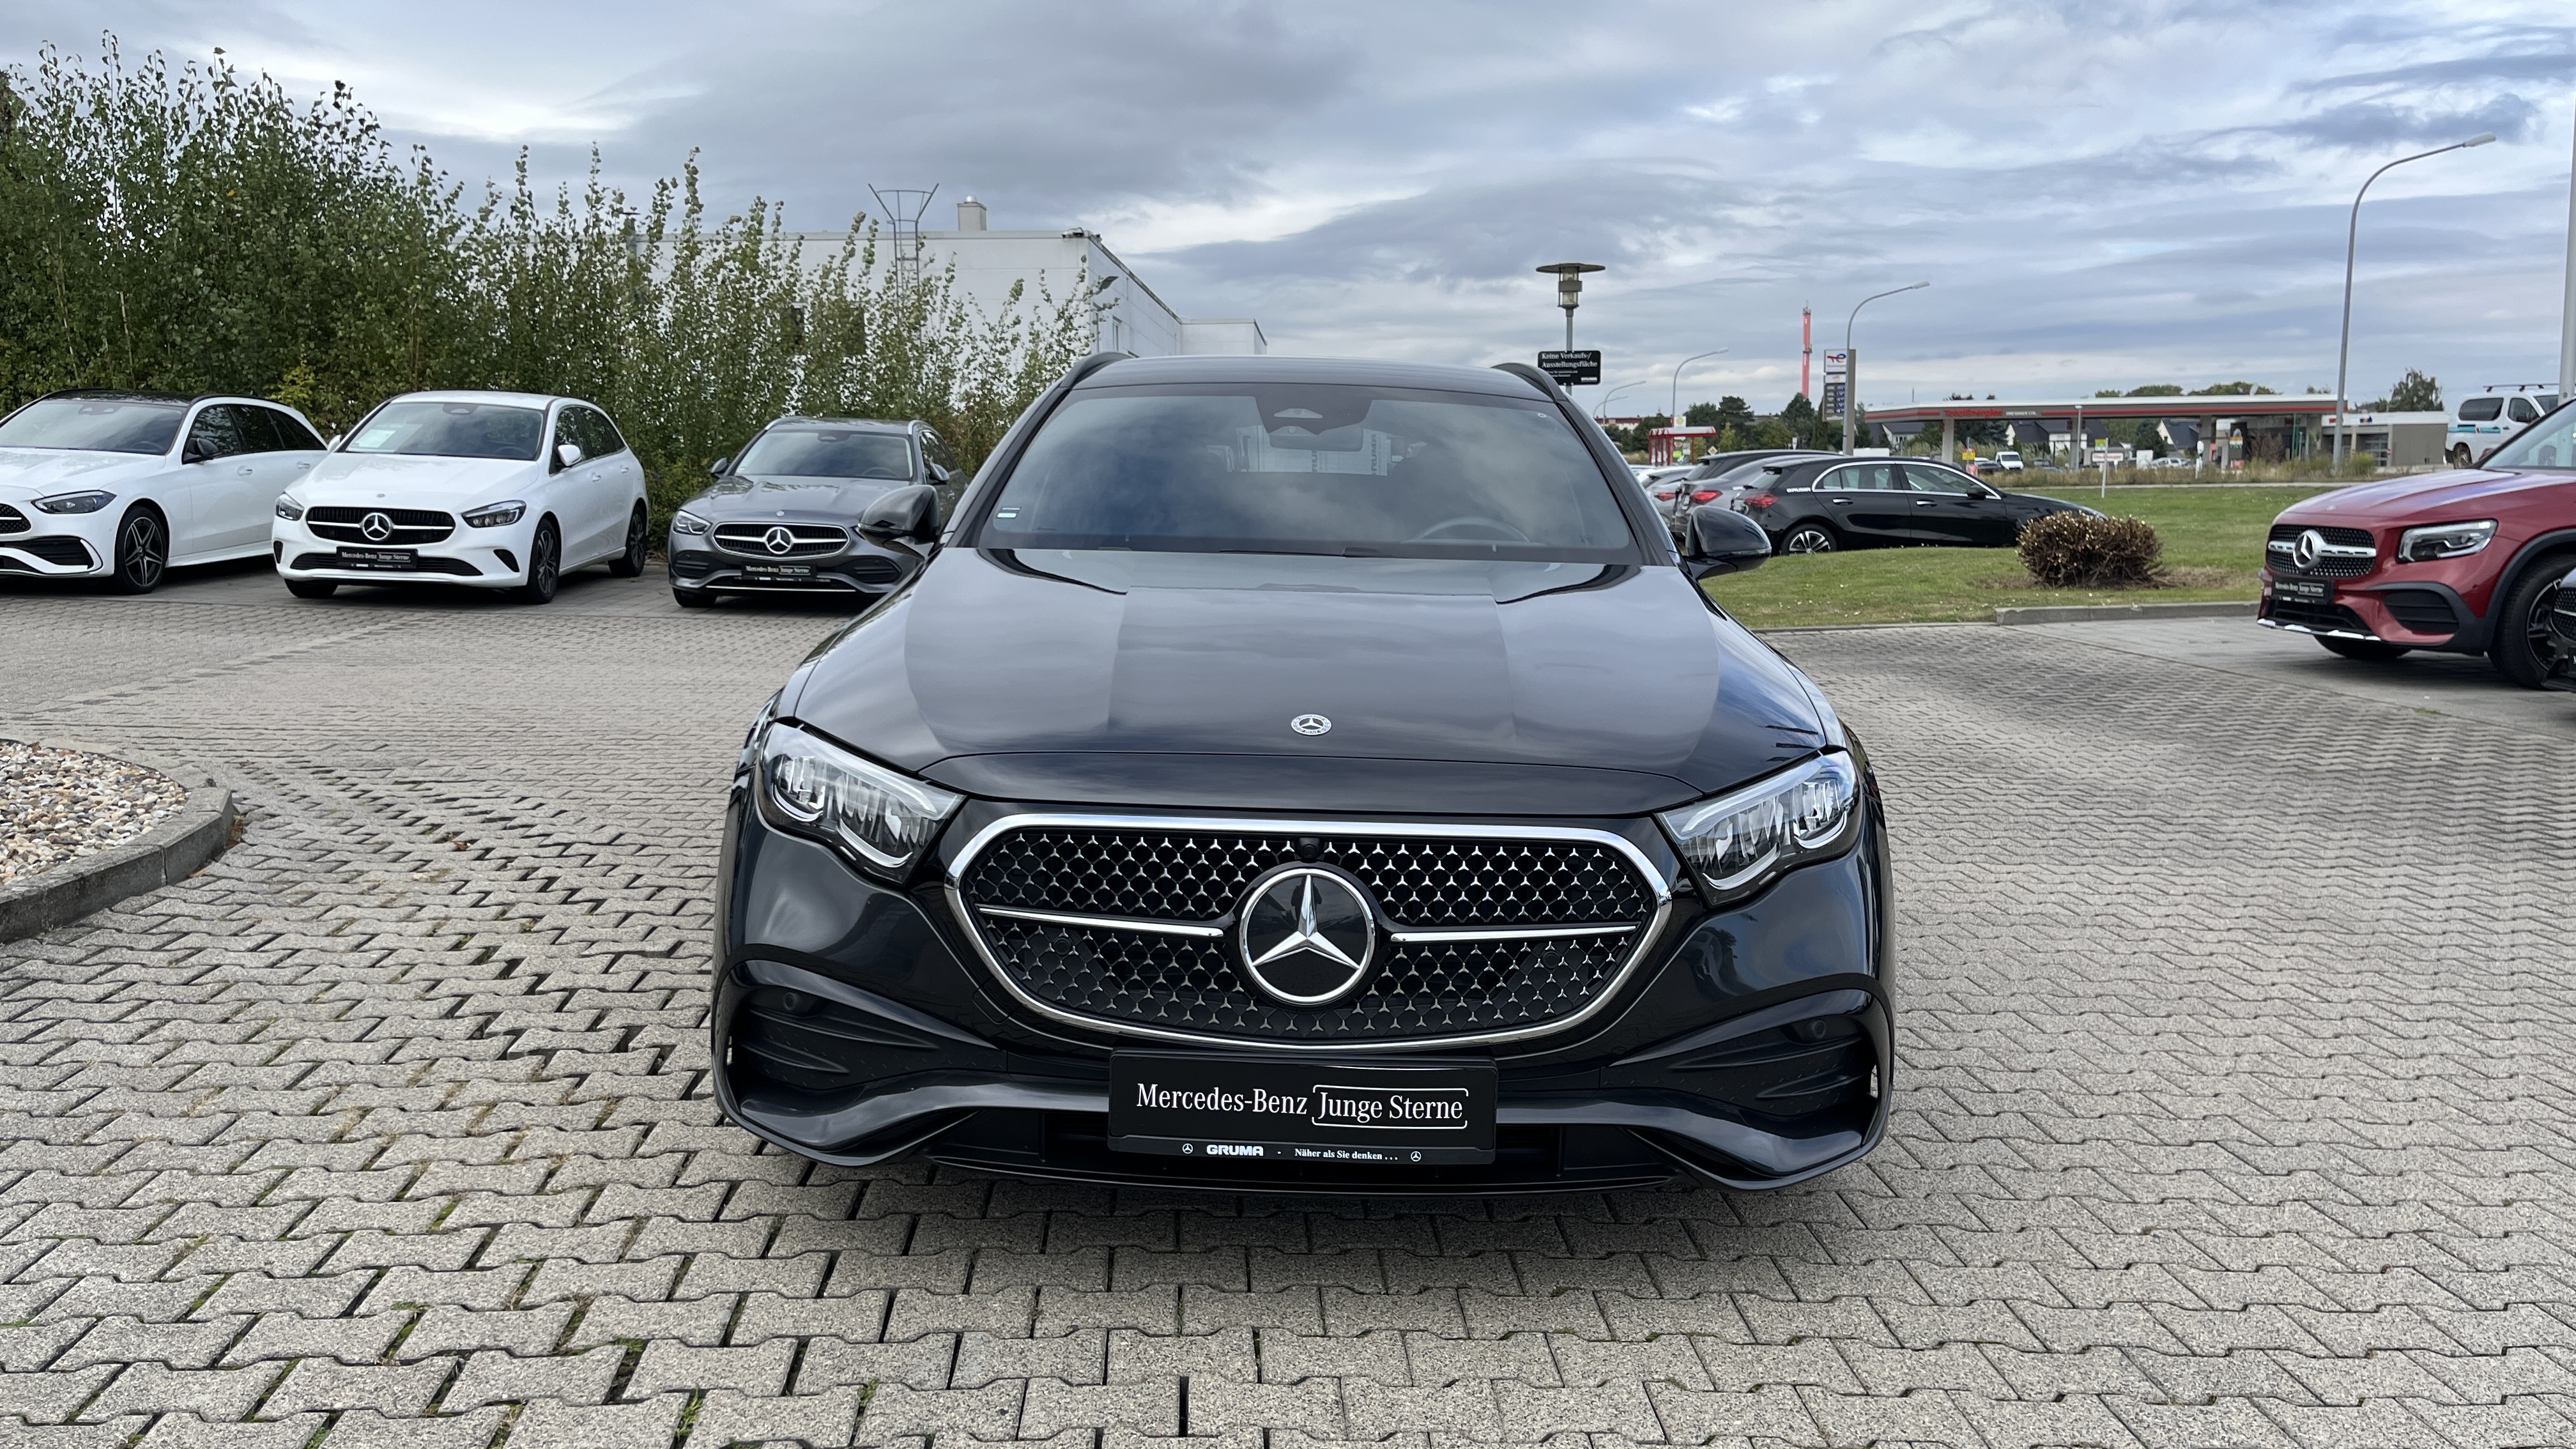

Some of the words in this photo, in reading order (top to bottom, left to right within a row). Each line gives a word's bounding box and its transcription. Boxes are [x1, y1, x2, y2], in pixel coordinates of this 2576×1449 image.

[1136, 1082, 1308, 1115] Mercedes-Benz
[1317, 1091, 1383, 1123] Junge
[1389, 1094, 1463, 1119] Sterne
[1206, 1144, 1264, 1156] GRUMA
[1294, 1148, 1321, 1158] Näher
[1323, 1149, 1335, 1158] als
[1337, 1150, 1350, 1159] Sie
[1351, 1151, 1383, 1160] denken
